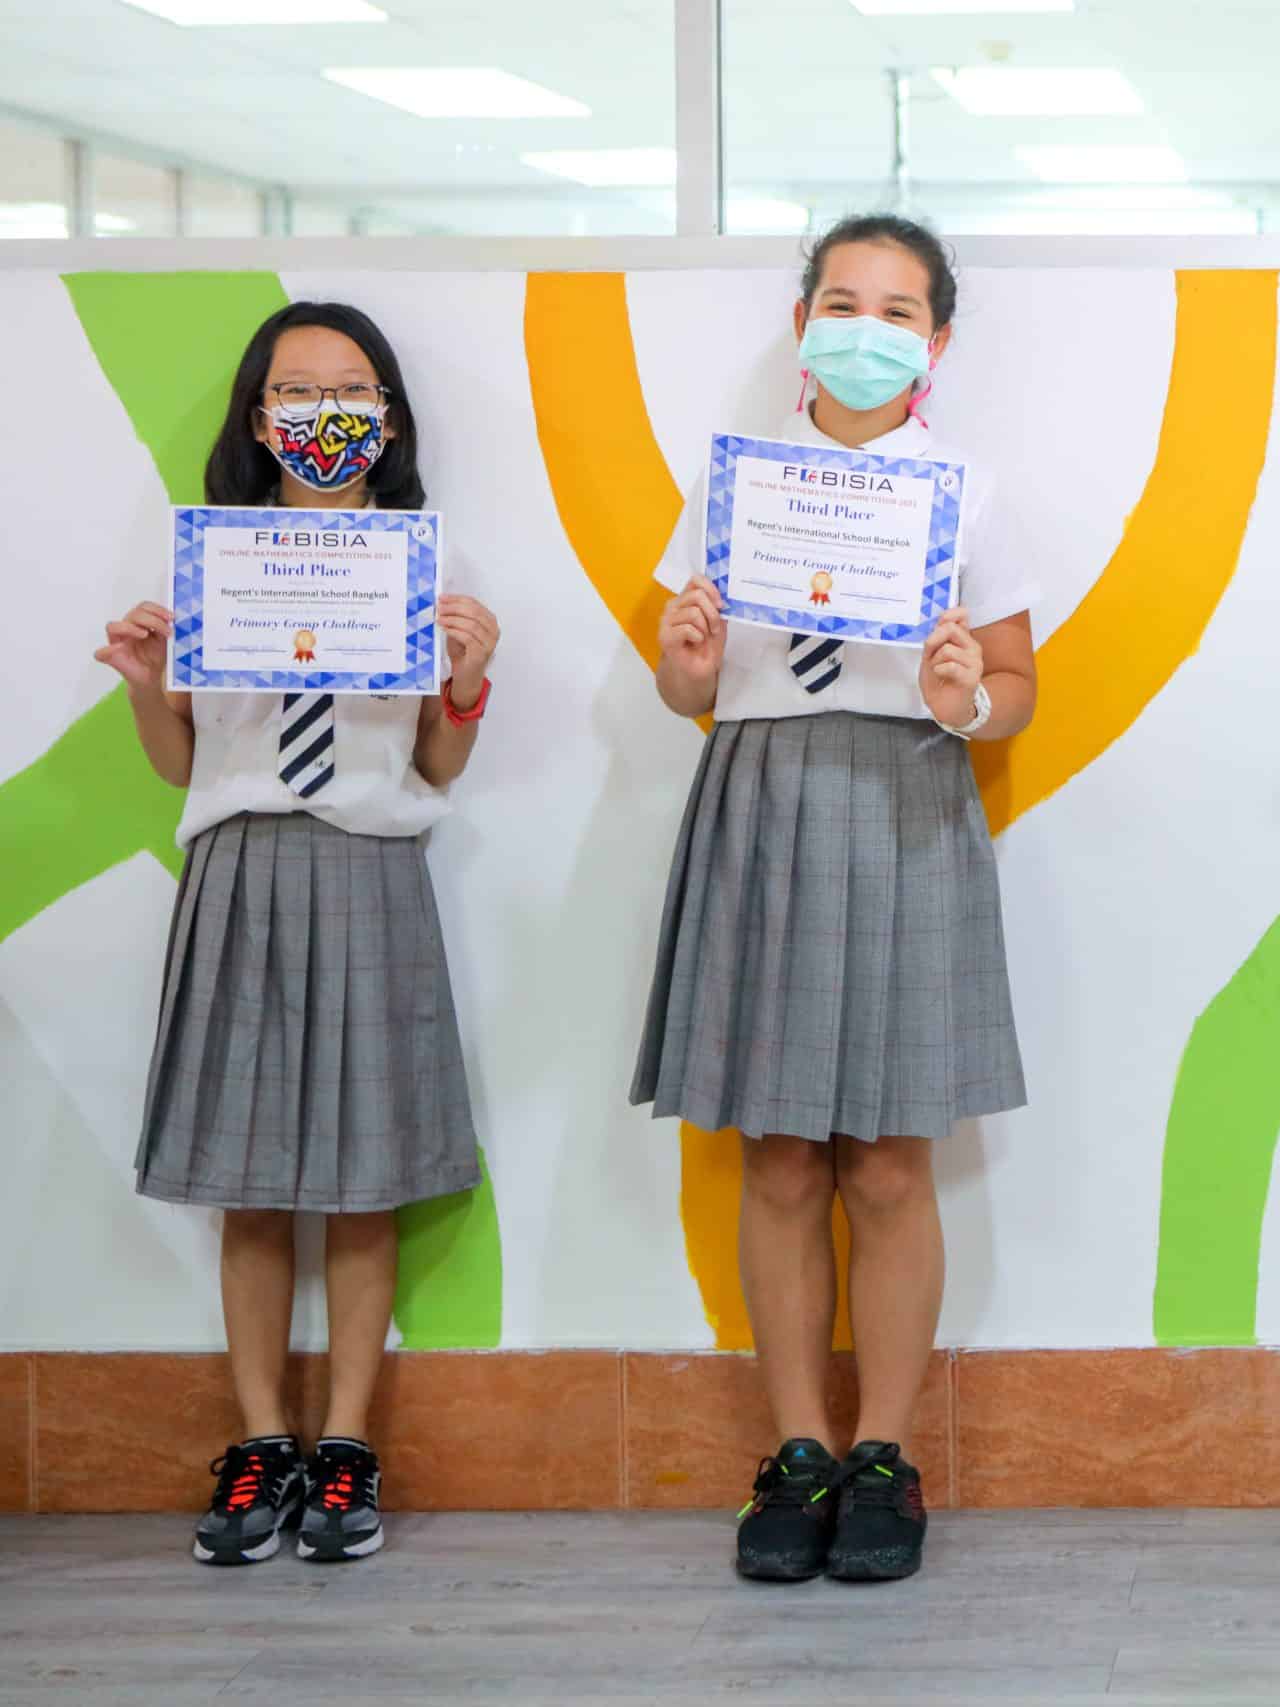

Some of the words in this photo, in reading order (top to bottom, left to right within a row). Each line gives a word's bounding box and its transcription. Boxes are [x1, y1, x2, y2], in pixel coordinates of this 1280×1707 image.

[780, 483, 838, 499] MATHEMATICS
[786, 498, 829, 517] Third
[835, 504, 876, 521] Place
[747, 519, 782, 532] Regent's
[784, 525, 840, 540] International
[842, 532, 871, 543] School
[874, 536, 911, 547] Bangkok
[254, 550, 312, 558] MATHEMATICS
[318, 551, 372, 559] COMPETITION
[262, 562, 304, 576] Third
[311, 563, 351, 577] Place
[753, 551, 800, 568] Primary
[803, 558, 838, 573] Group
[841, 565, 900, 579] Challenge
[221, 588, 258, 598] Regent's
[261, 590, 318, 598] International
[321, 590, 350, 599] School
[352, 590, 389, 600] Bangkok
[229, 617, 280, 629] Primary
[284, 619, 319, 631] Group
[322, 619, 381, 631] Challenge
